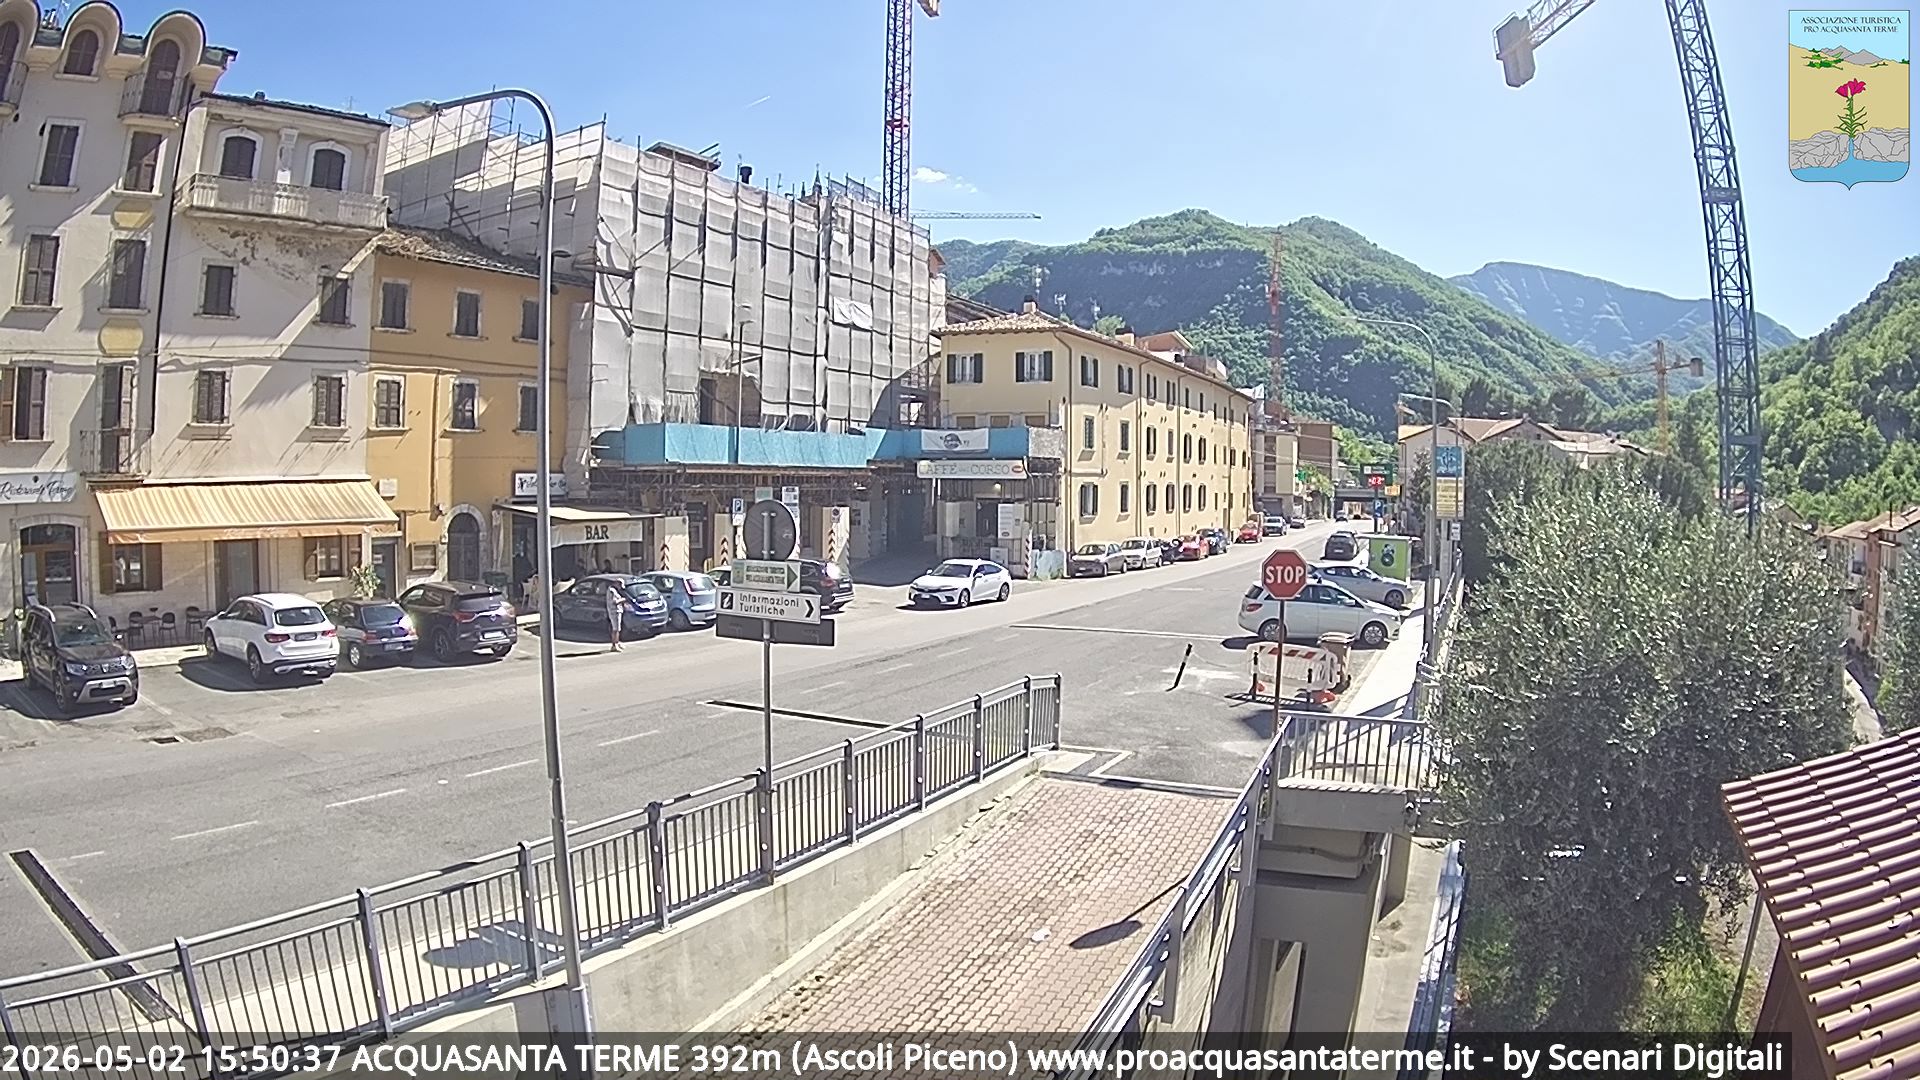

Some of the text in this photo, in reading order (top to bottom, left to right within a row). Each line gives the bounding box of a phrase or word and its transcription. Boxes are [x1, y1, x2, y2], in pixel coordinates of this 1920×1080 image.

[971, 464, 1010, 475] CORSO
[585, 525, 609, 540] BAR
[1265, 565, 1305, 584] STOP
[739, 592, 799, 608] Informazioni
[739, 602, 785, 616] Turistiche
